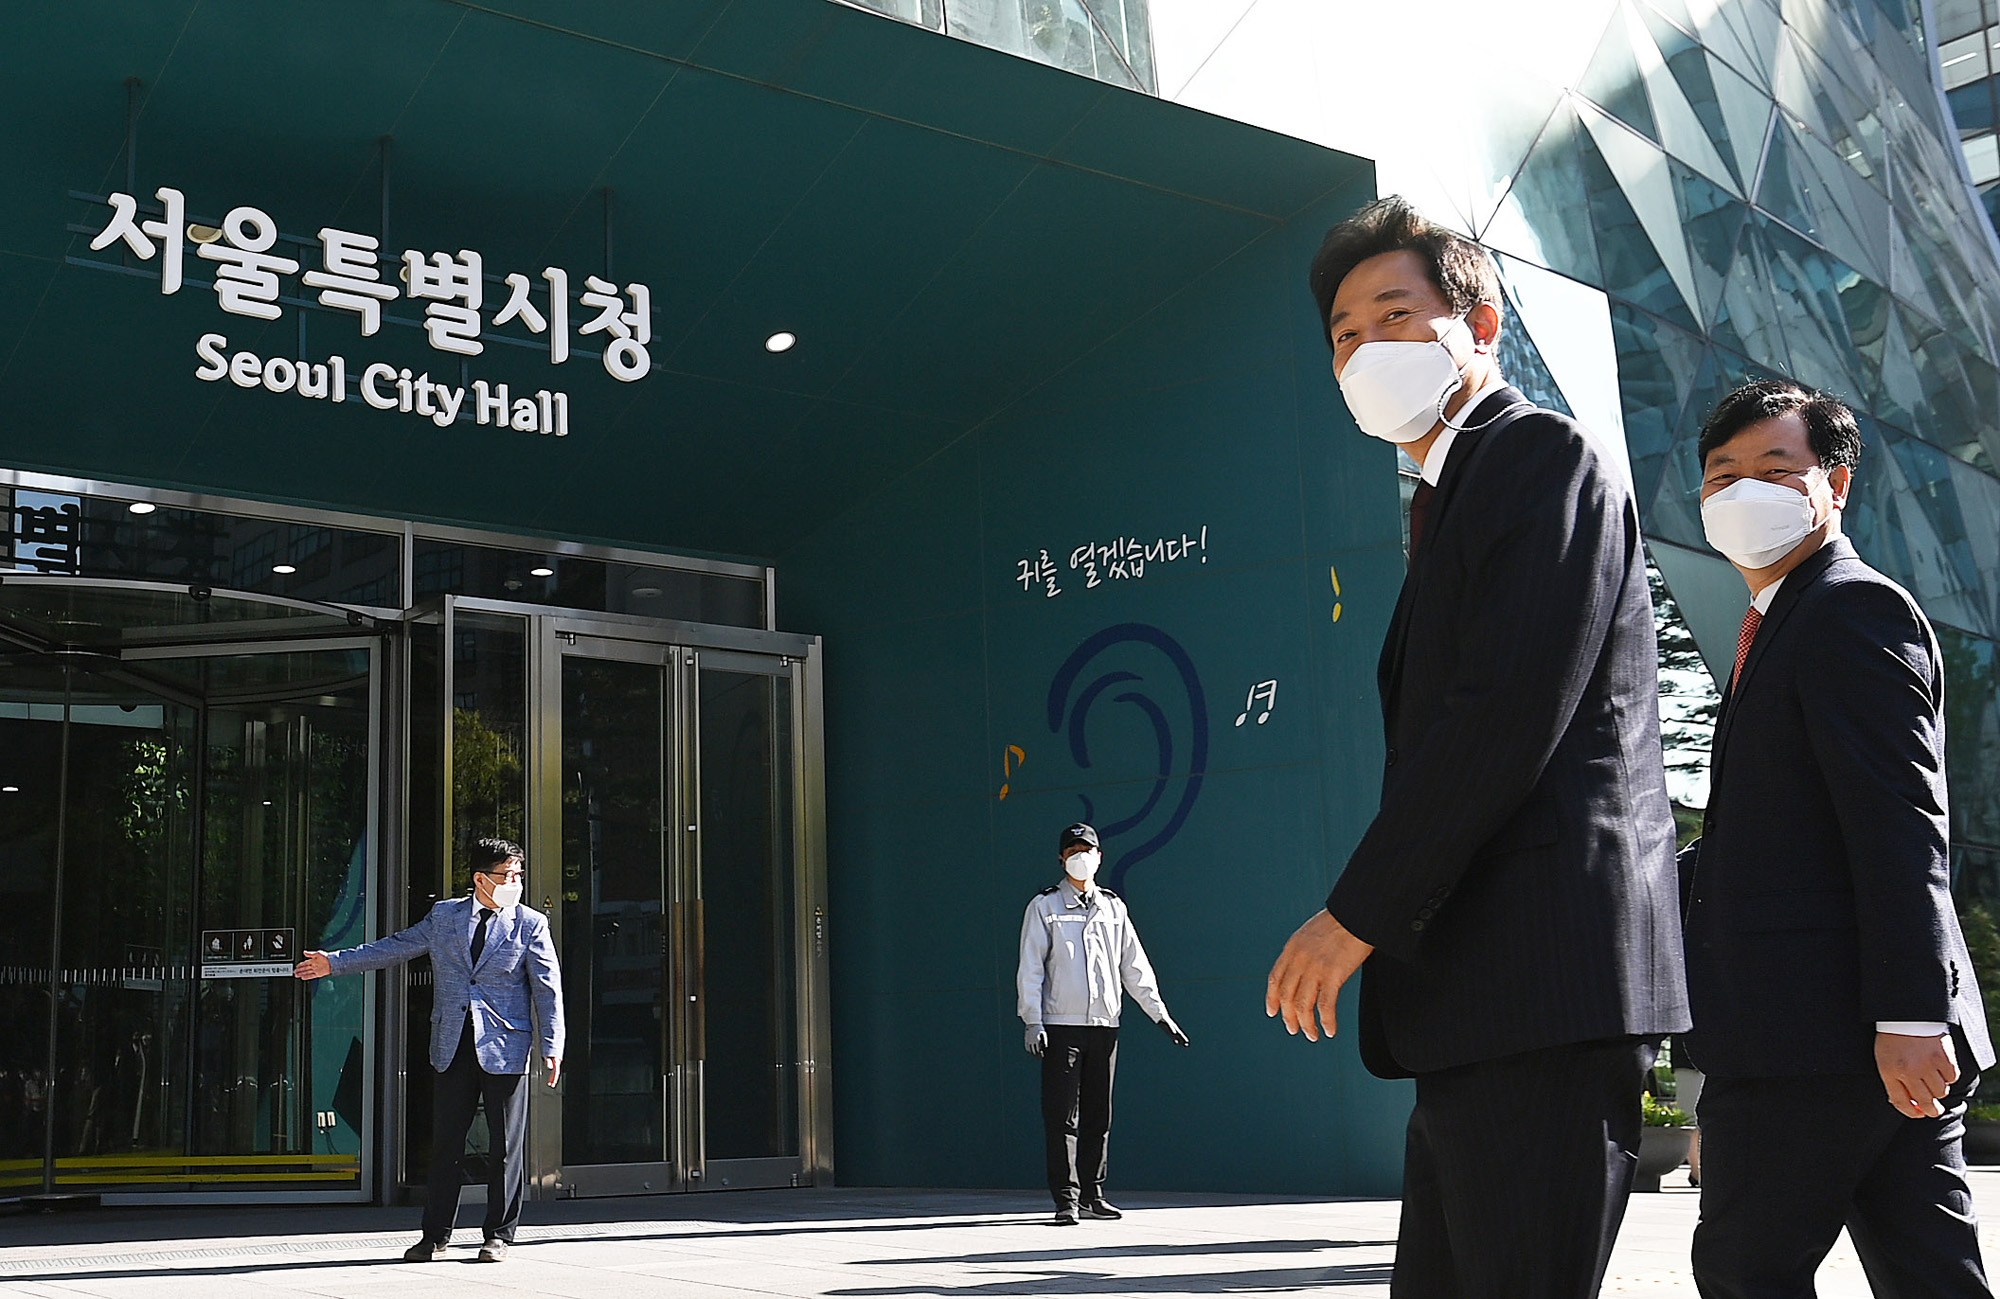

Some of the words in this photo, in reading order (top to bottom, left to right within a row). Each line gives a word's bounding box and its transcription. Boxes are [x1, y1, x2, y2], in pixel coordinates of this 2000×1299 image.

[90, 187, 652, 382] 서울특별시청
[195, 333, 346, 403] Seoul
[360, 362, 465, 427] City
[471, 380, 569, 437] Hall
[1016, 549, 1062, 598] 귀를
[1069, 524, 1208, 589] 열겠습니다!
